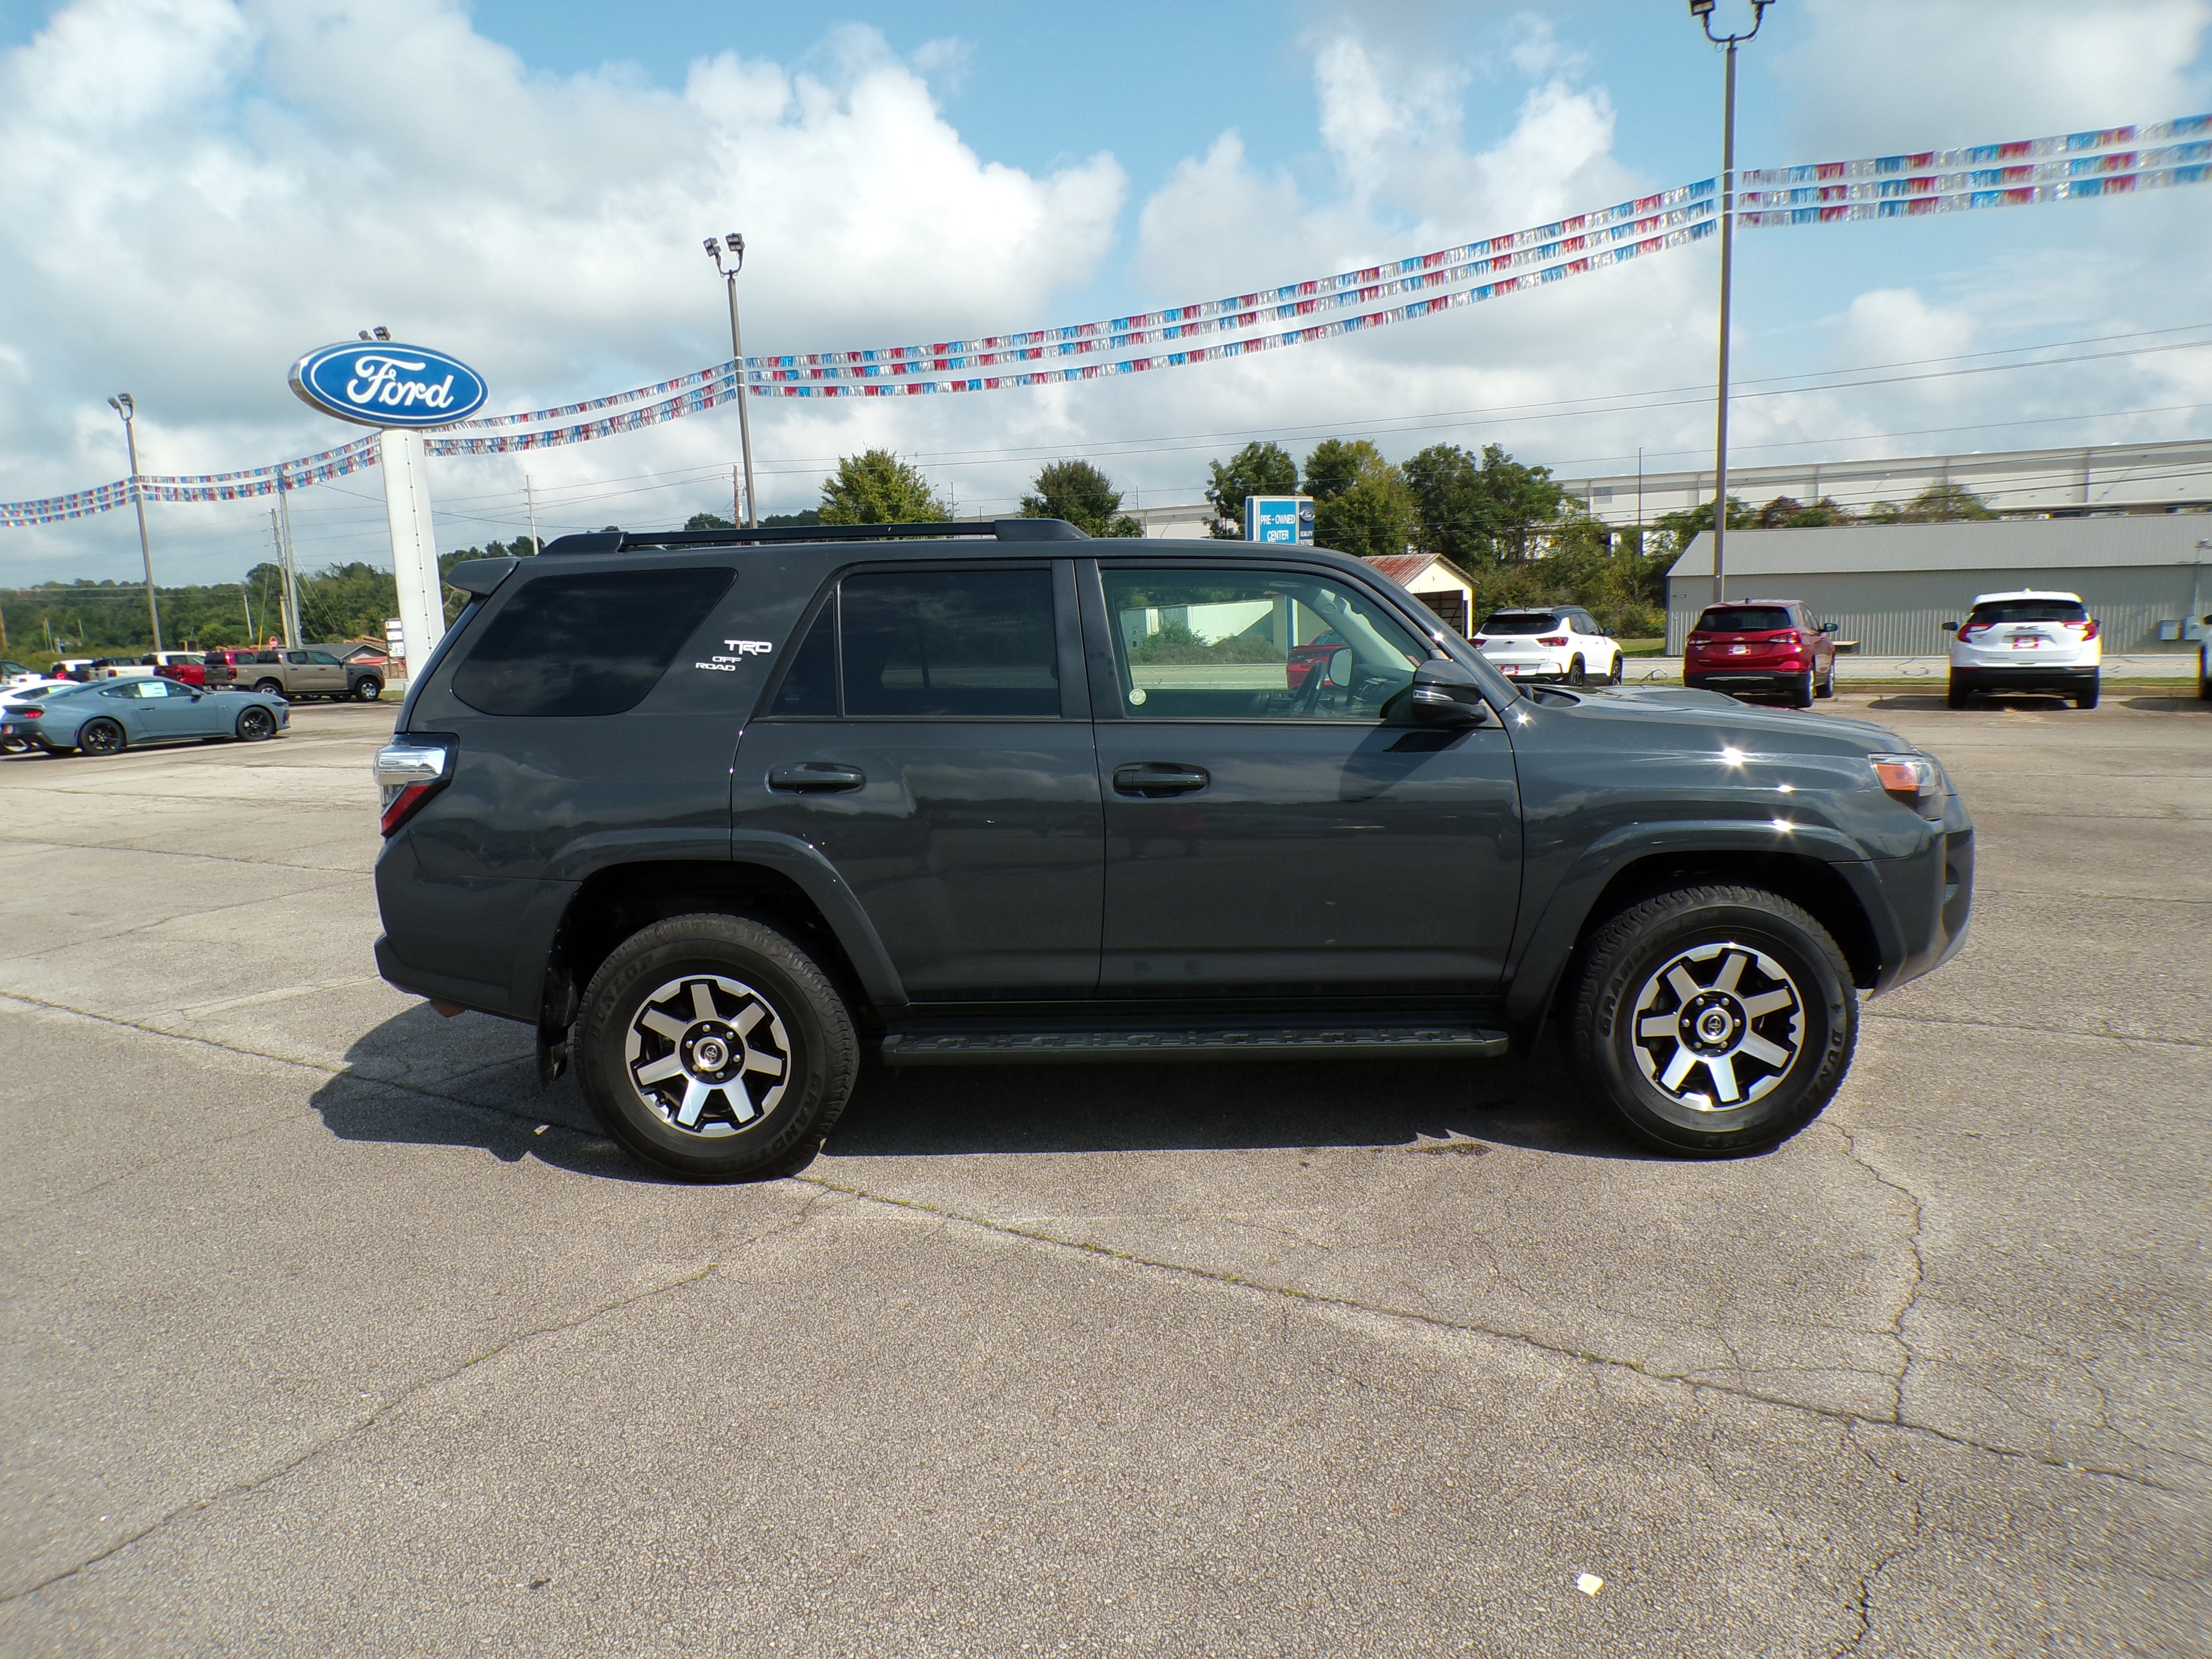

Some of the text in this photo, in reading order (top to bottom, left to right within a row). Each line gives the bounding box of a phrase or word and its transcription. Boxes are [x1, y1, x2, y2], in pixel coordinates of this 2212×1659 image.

[346, 355, 454, 408] Ford
[1267, 530, 1289, 541] CENTER
[724, 640, 772, 656] TRD
[695, 662, 736, 671] ROAD
[592, 953, 653, 1039] DUNLOP
